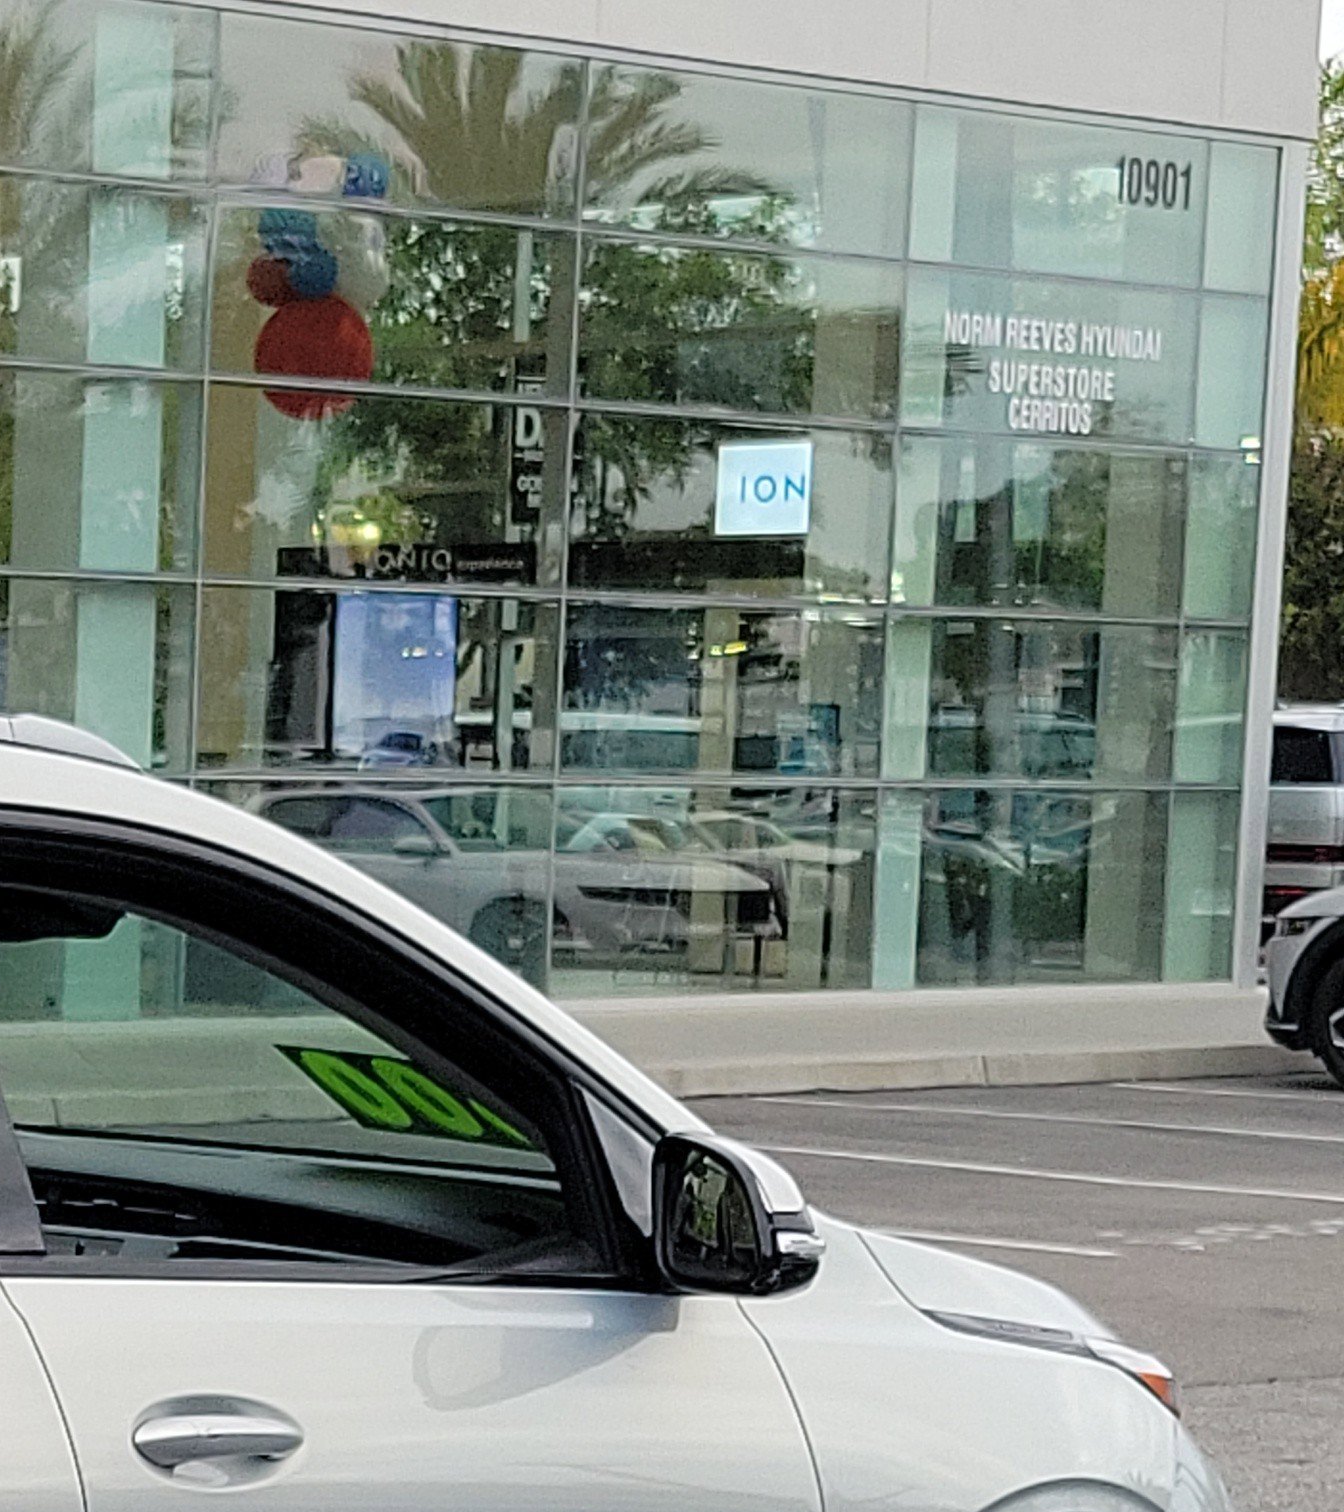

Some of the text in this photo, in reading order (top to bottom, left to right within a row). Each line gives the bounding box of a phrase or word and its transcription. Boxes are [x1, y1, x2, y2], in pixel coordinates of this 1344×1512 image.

[1115, 154, 1191, 210] 10901
[945, 311, 1162, 361] NORM REEVES HYUNDAI
[989, 360, 1115, 400] SUPERSTORE
[1008, 397, 1093, 435] CERRITOS
[741, 474, 806, 503] ION
